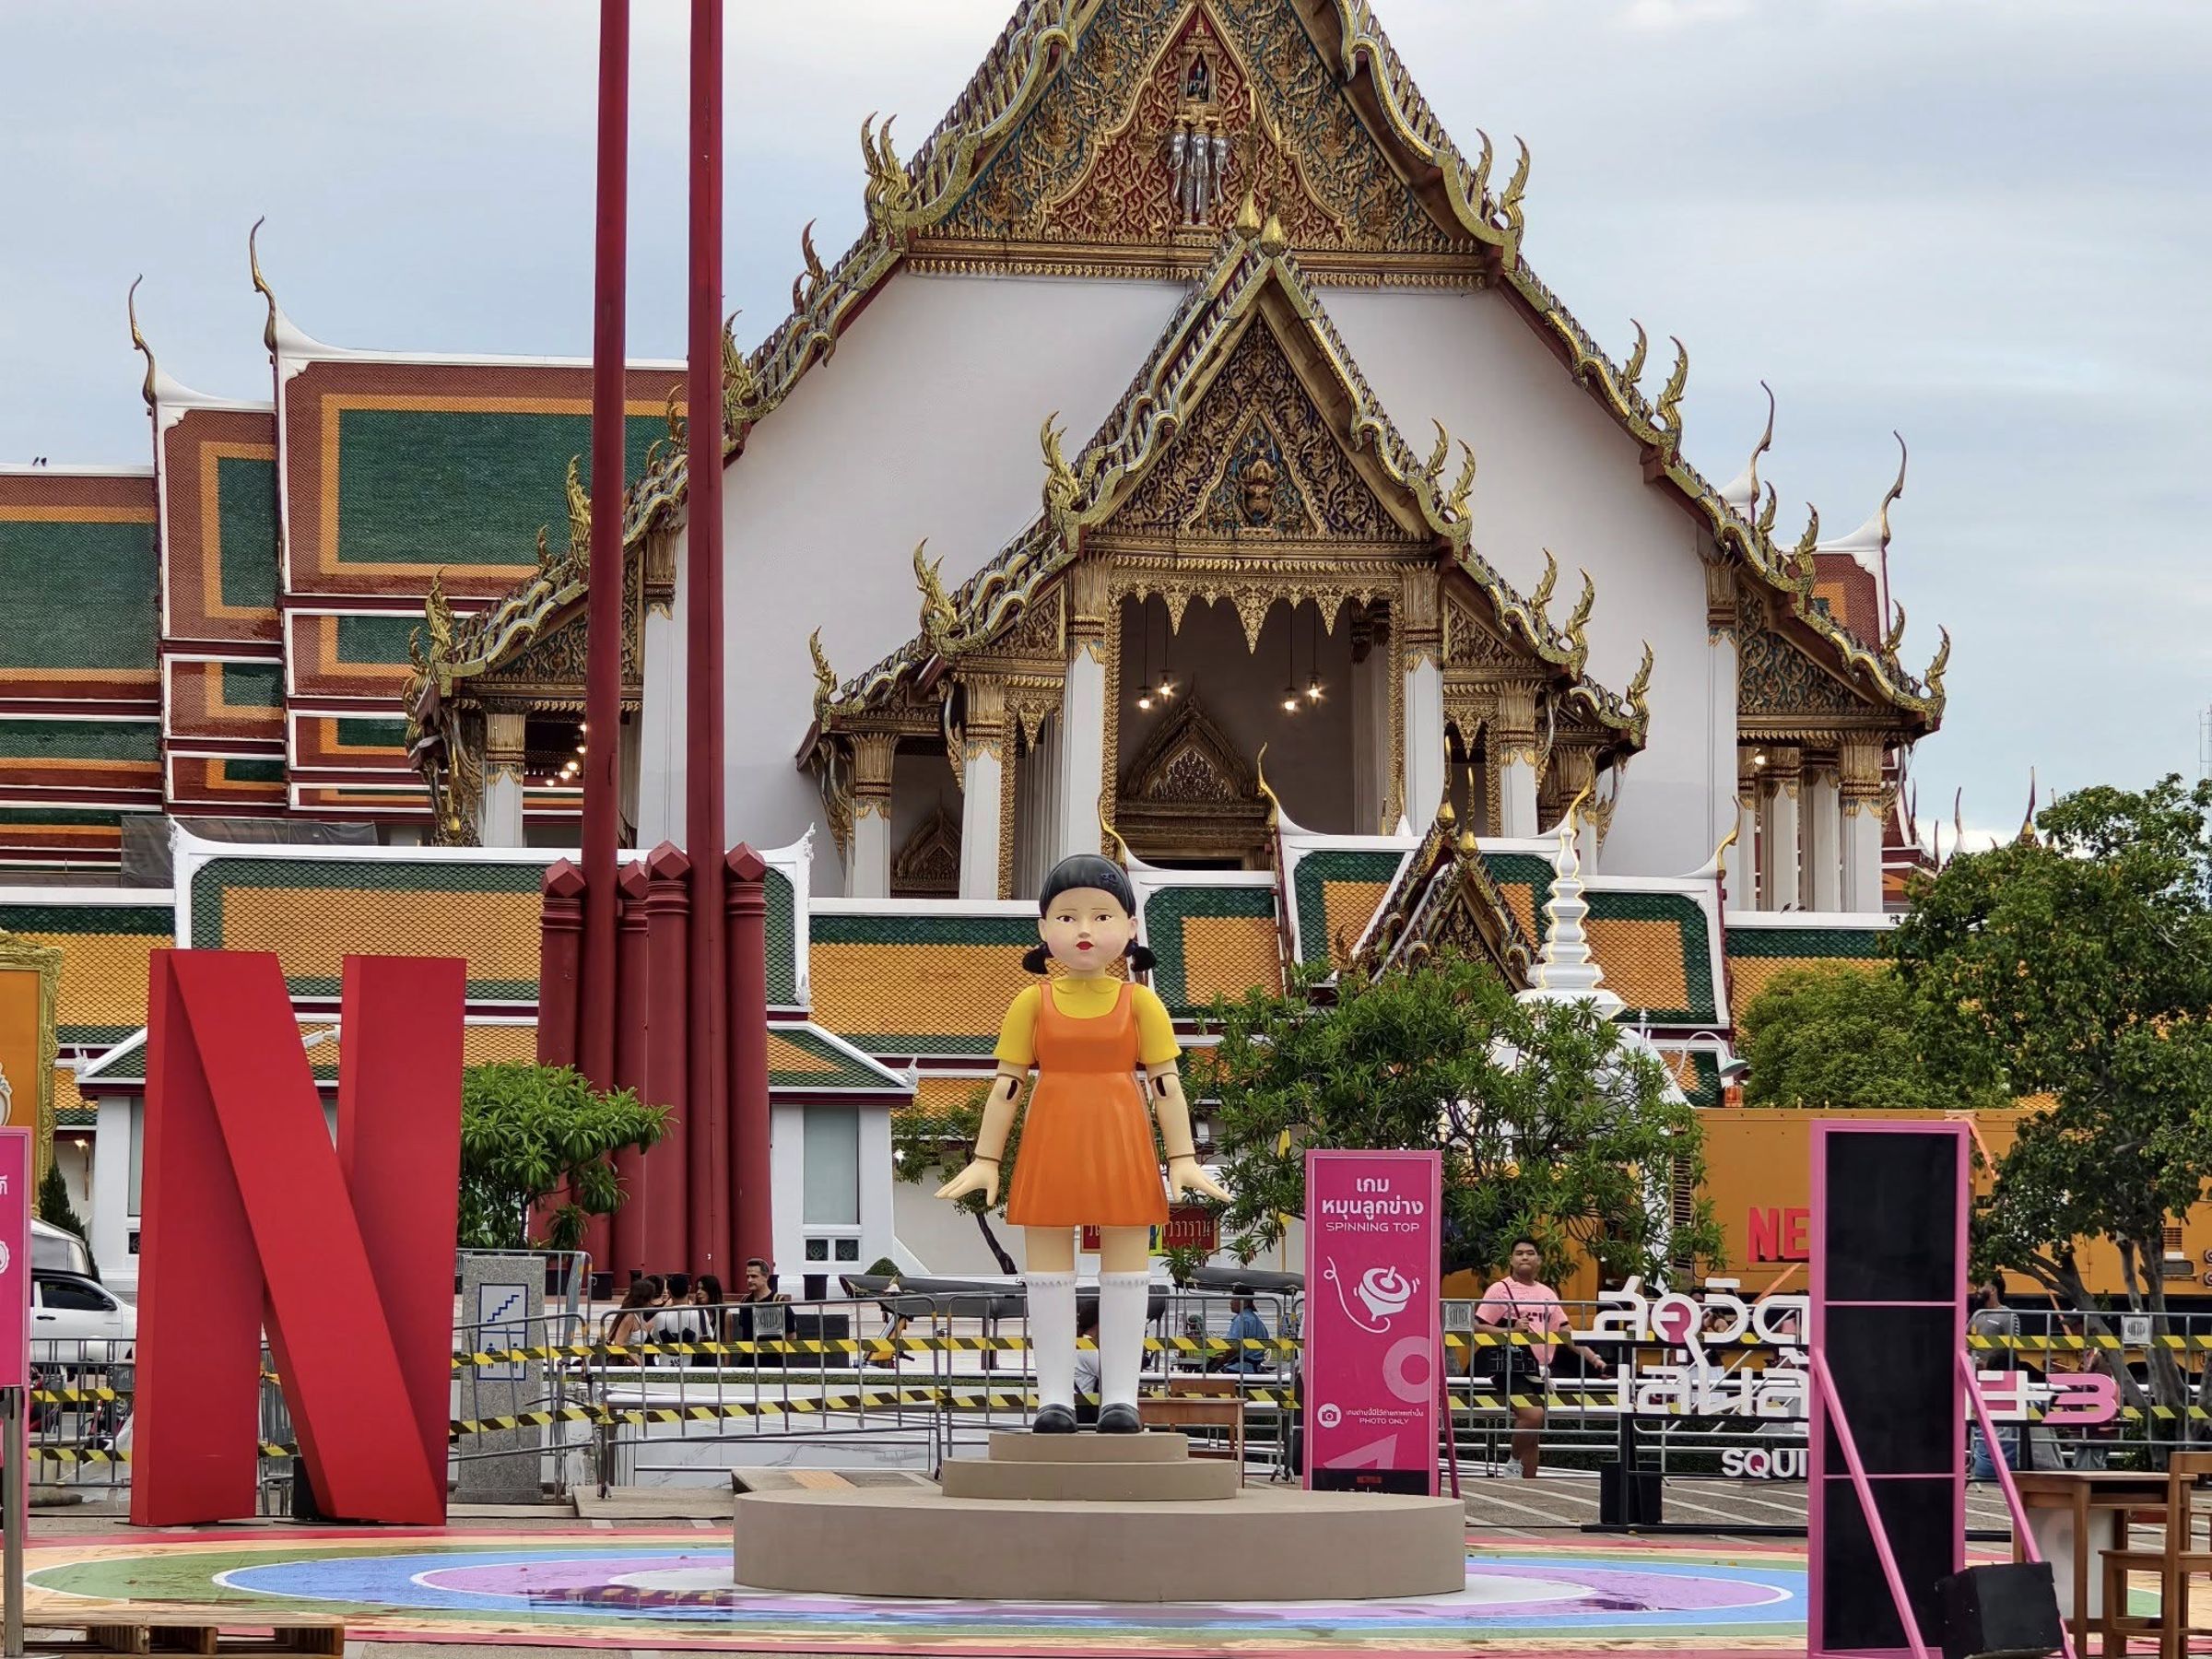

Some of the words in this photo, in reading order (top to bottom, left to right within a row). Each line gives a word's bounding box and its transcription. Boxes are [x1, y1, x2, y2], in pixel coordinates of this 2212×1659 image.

[1356, 1178, 1390, 1193] เกม
[1322, 1194, 1425, 1220] หมุนลูกข่าง
[130, 948, 467, 1526] N
[1325, 1222, 1390, 1232] SPINNING
[1393, 1222, 1420, 1232] TOP
[1748, 1206, 1810, 1261] NE
[1359, 1417, 1387, 1425] PHOTO
[1388, 1417, 1409, 1425] ONLY
[1721, 1449, 1808, 1479] SQUI
